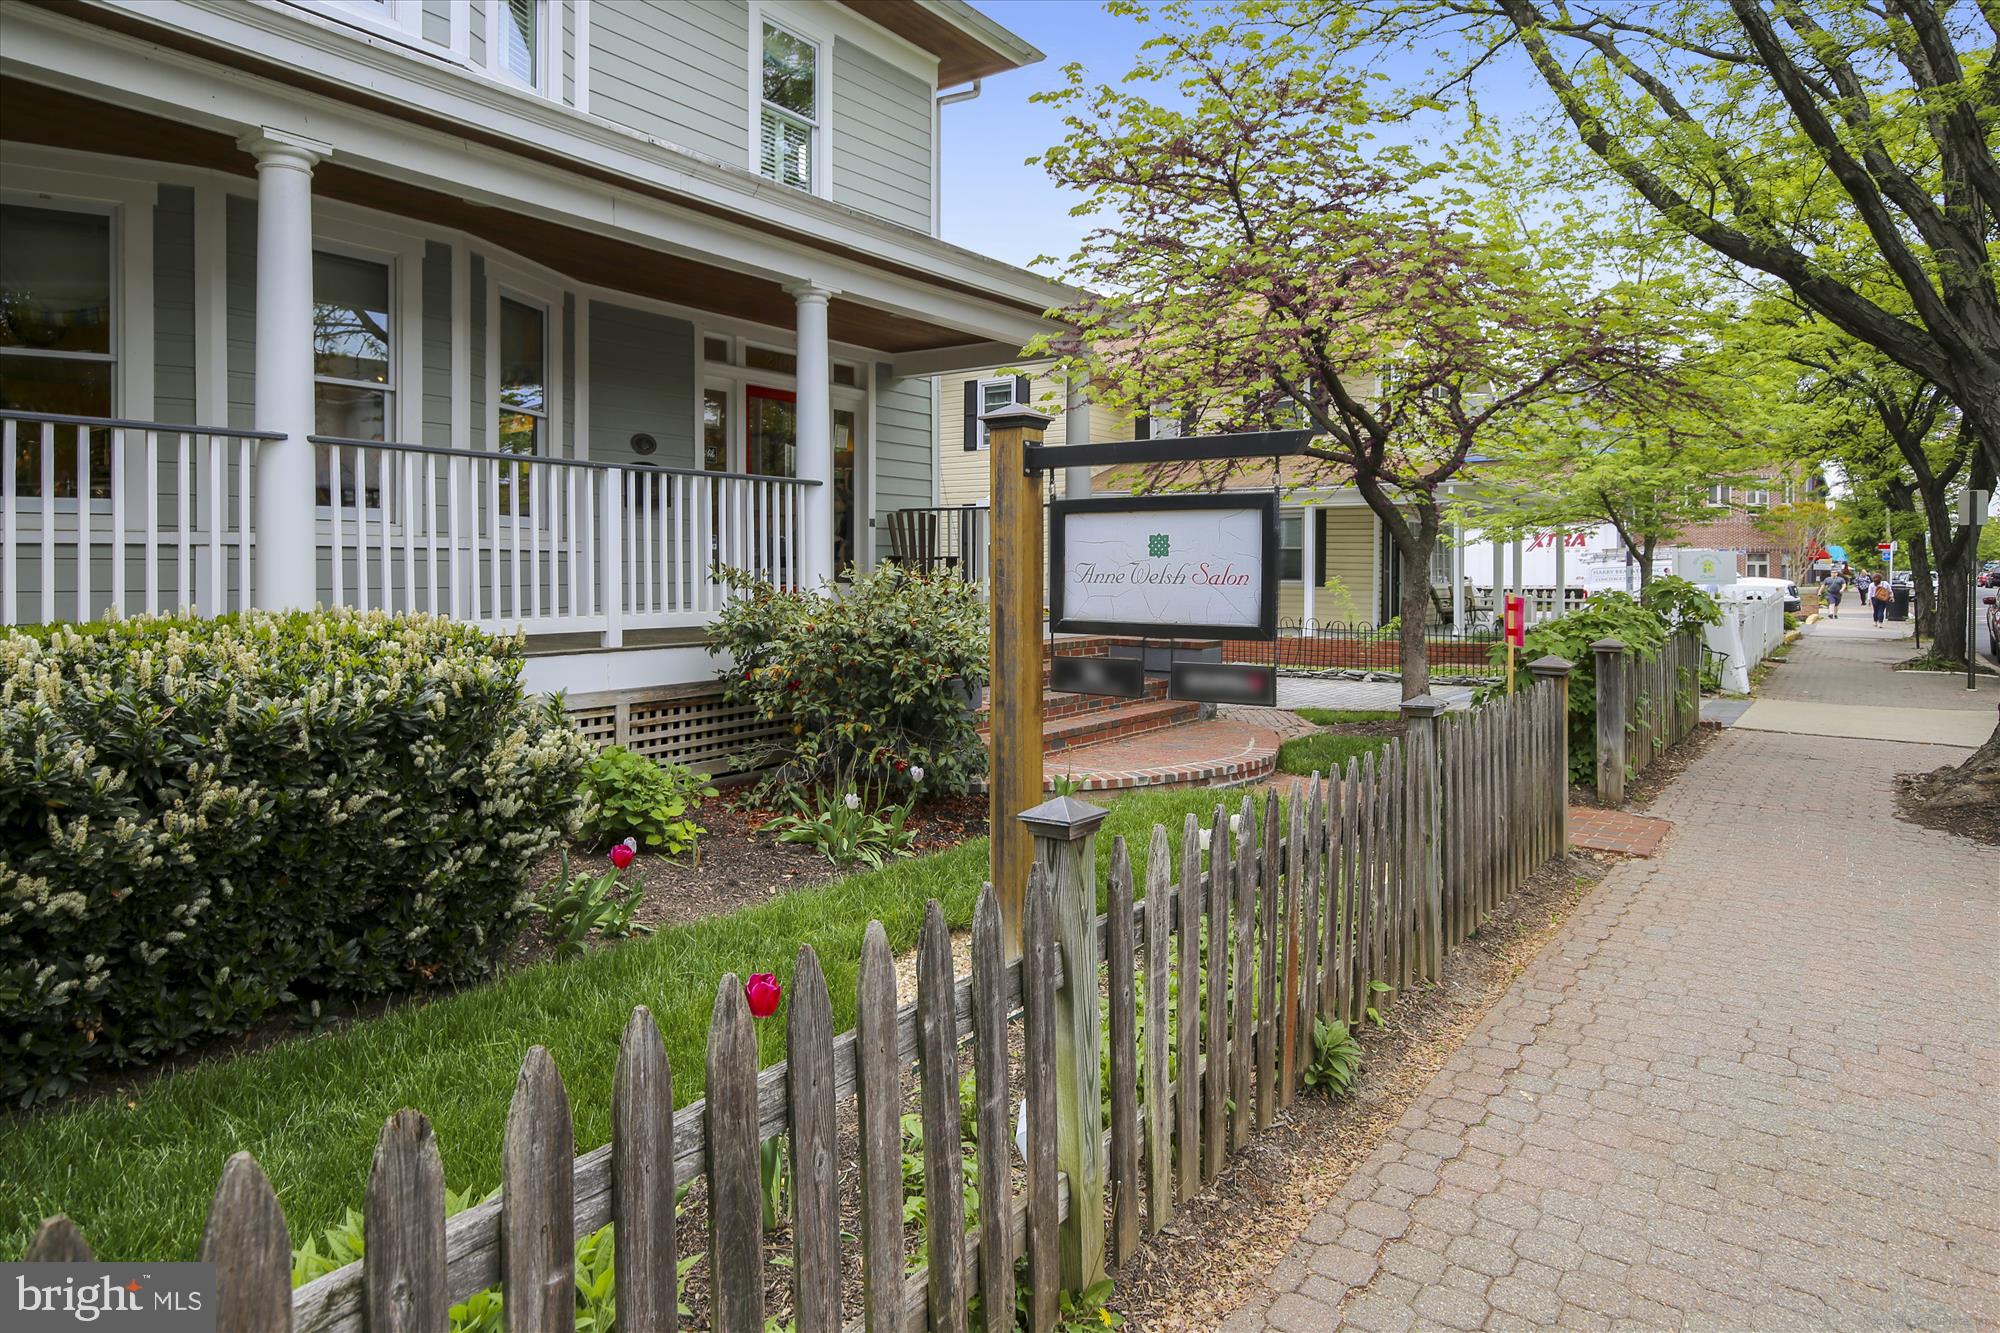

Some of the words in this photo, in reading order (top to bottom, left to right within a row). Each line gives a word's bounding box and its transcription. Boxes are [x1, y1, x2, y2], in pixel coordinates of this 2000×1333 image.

[1073, 562, 1125, 584] Anne
[1129, 562, 1189, 585] Welsh
[1191, 561, 1251, 586] Salon
